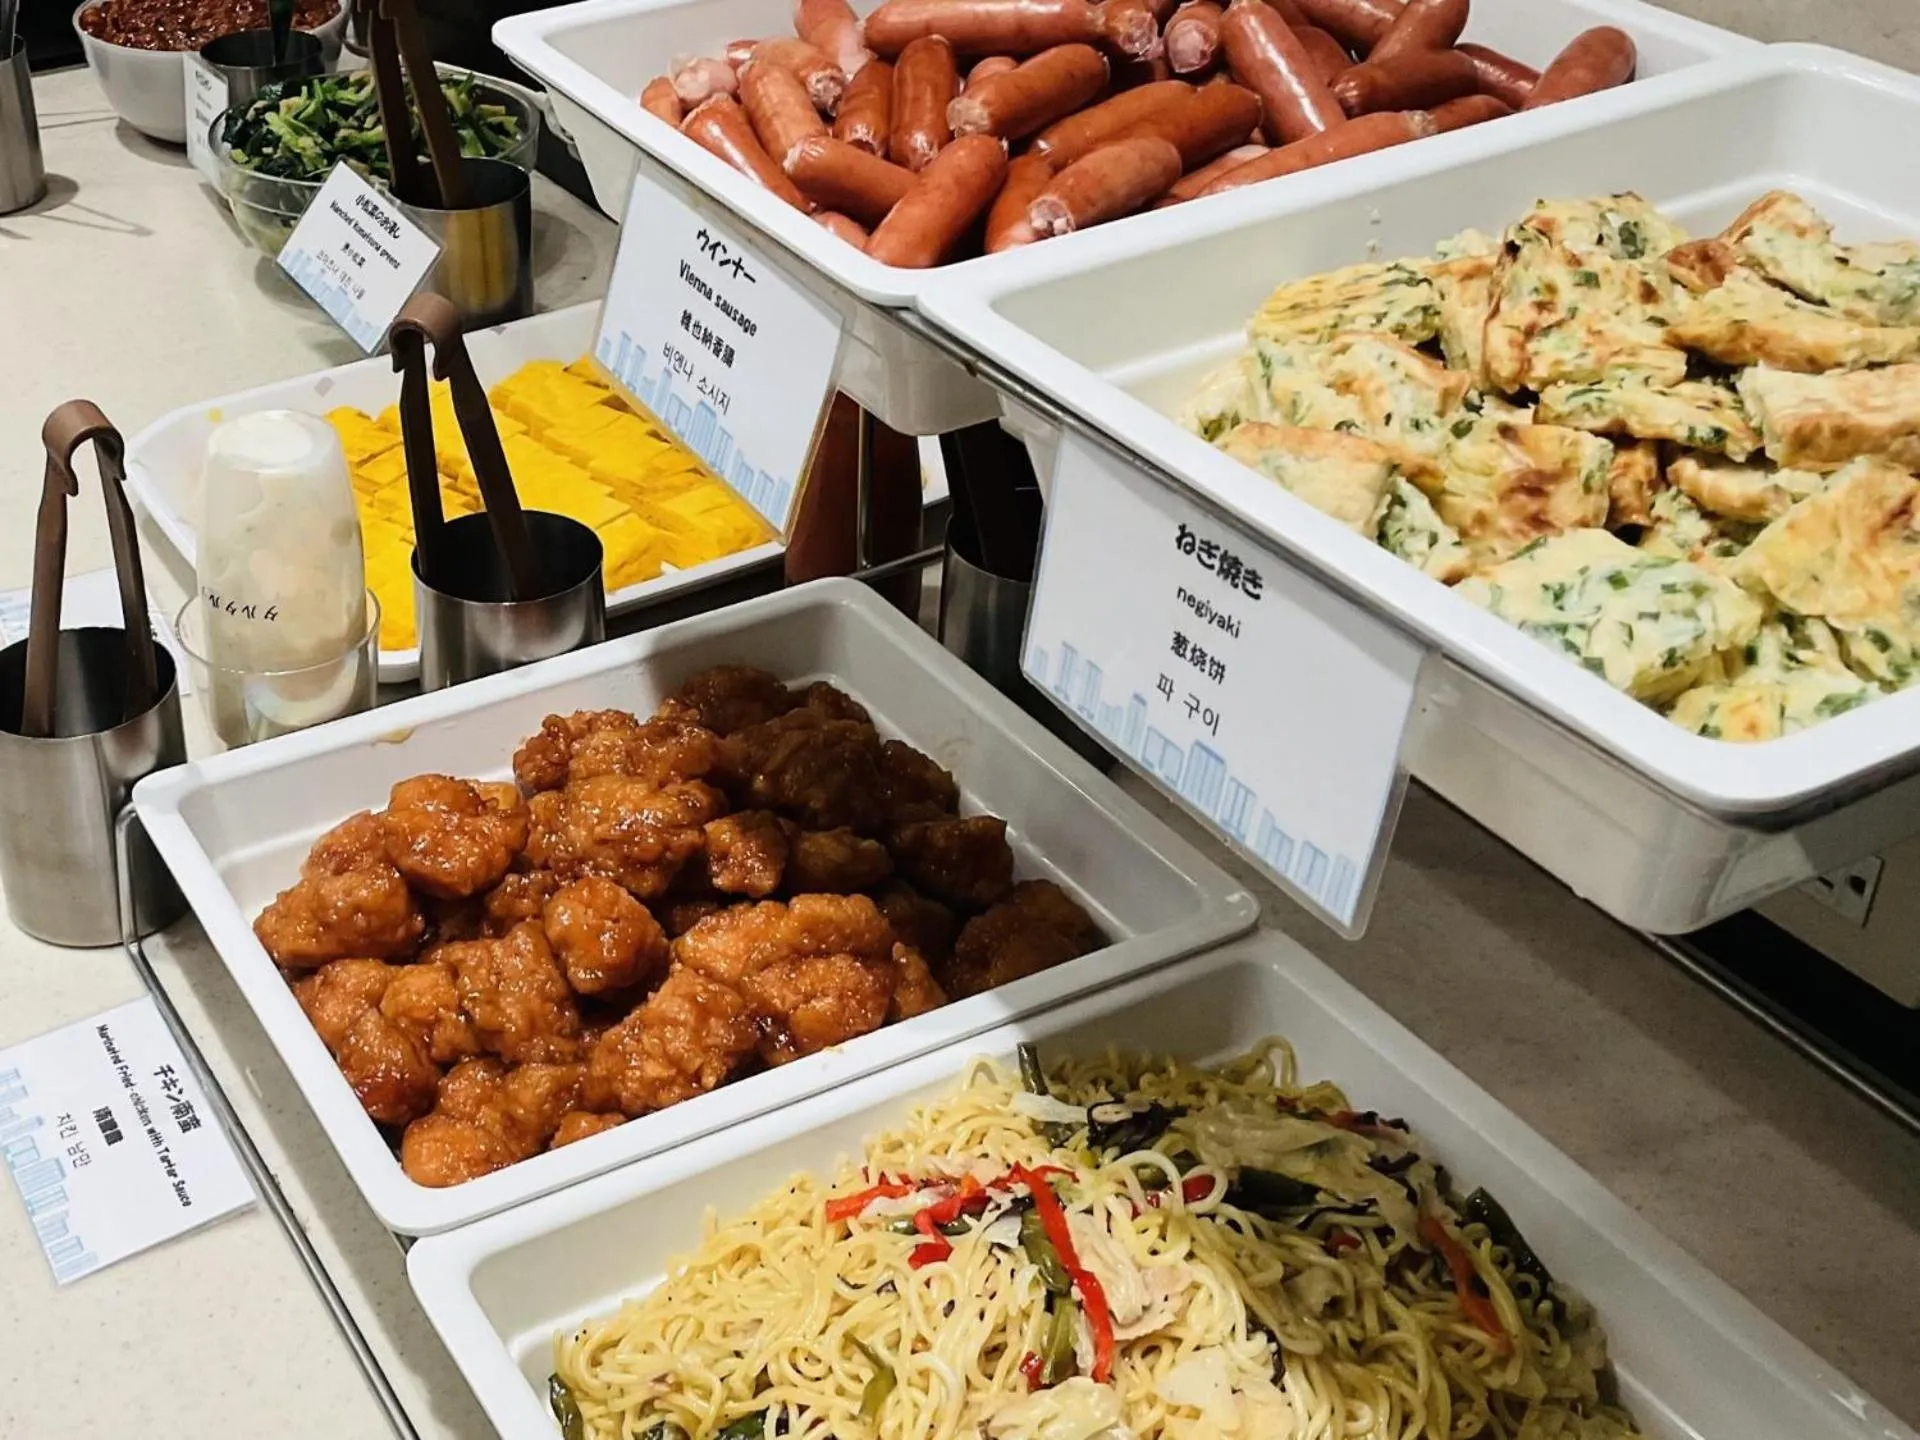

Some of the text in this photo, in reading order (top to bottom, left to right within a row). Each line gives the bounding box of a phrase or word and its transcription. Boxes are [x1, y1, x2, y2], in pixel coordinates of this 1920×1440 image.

[696, 228, 756, 283] ウインナー
[679, 259, 758, 337] Vienna sausage
[662, 341, 730, 415] 비엔나 소시지
[1175, 523, 1264, 601] ねぎ焼き
[1176, 586, 1241, 639] negiyaki
[1170, 630, 1226, 685] 葱烧饼
[1156, 672, 1220, 737] 파 구이
[153, 1063, 202, 1134] チキン南蛮
[155, 1146, 179, 1179] Tartar
[172, 1179, 192, 1208] Sauce
